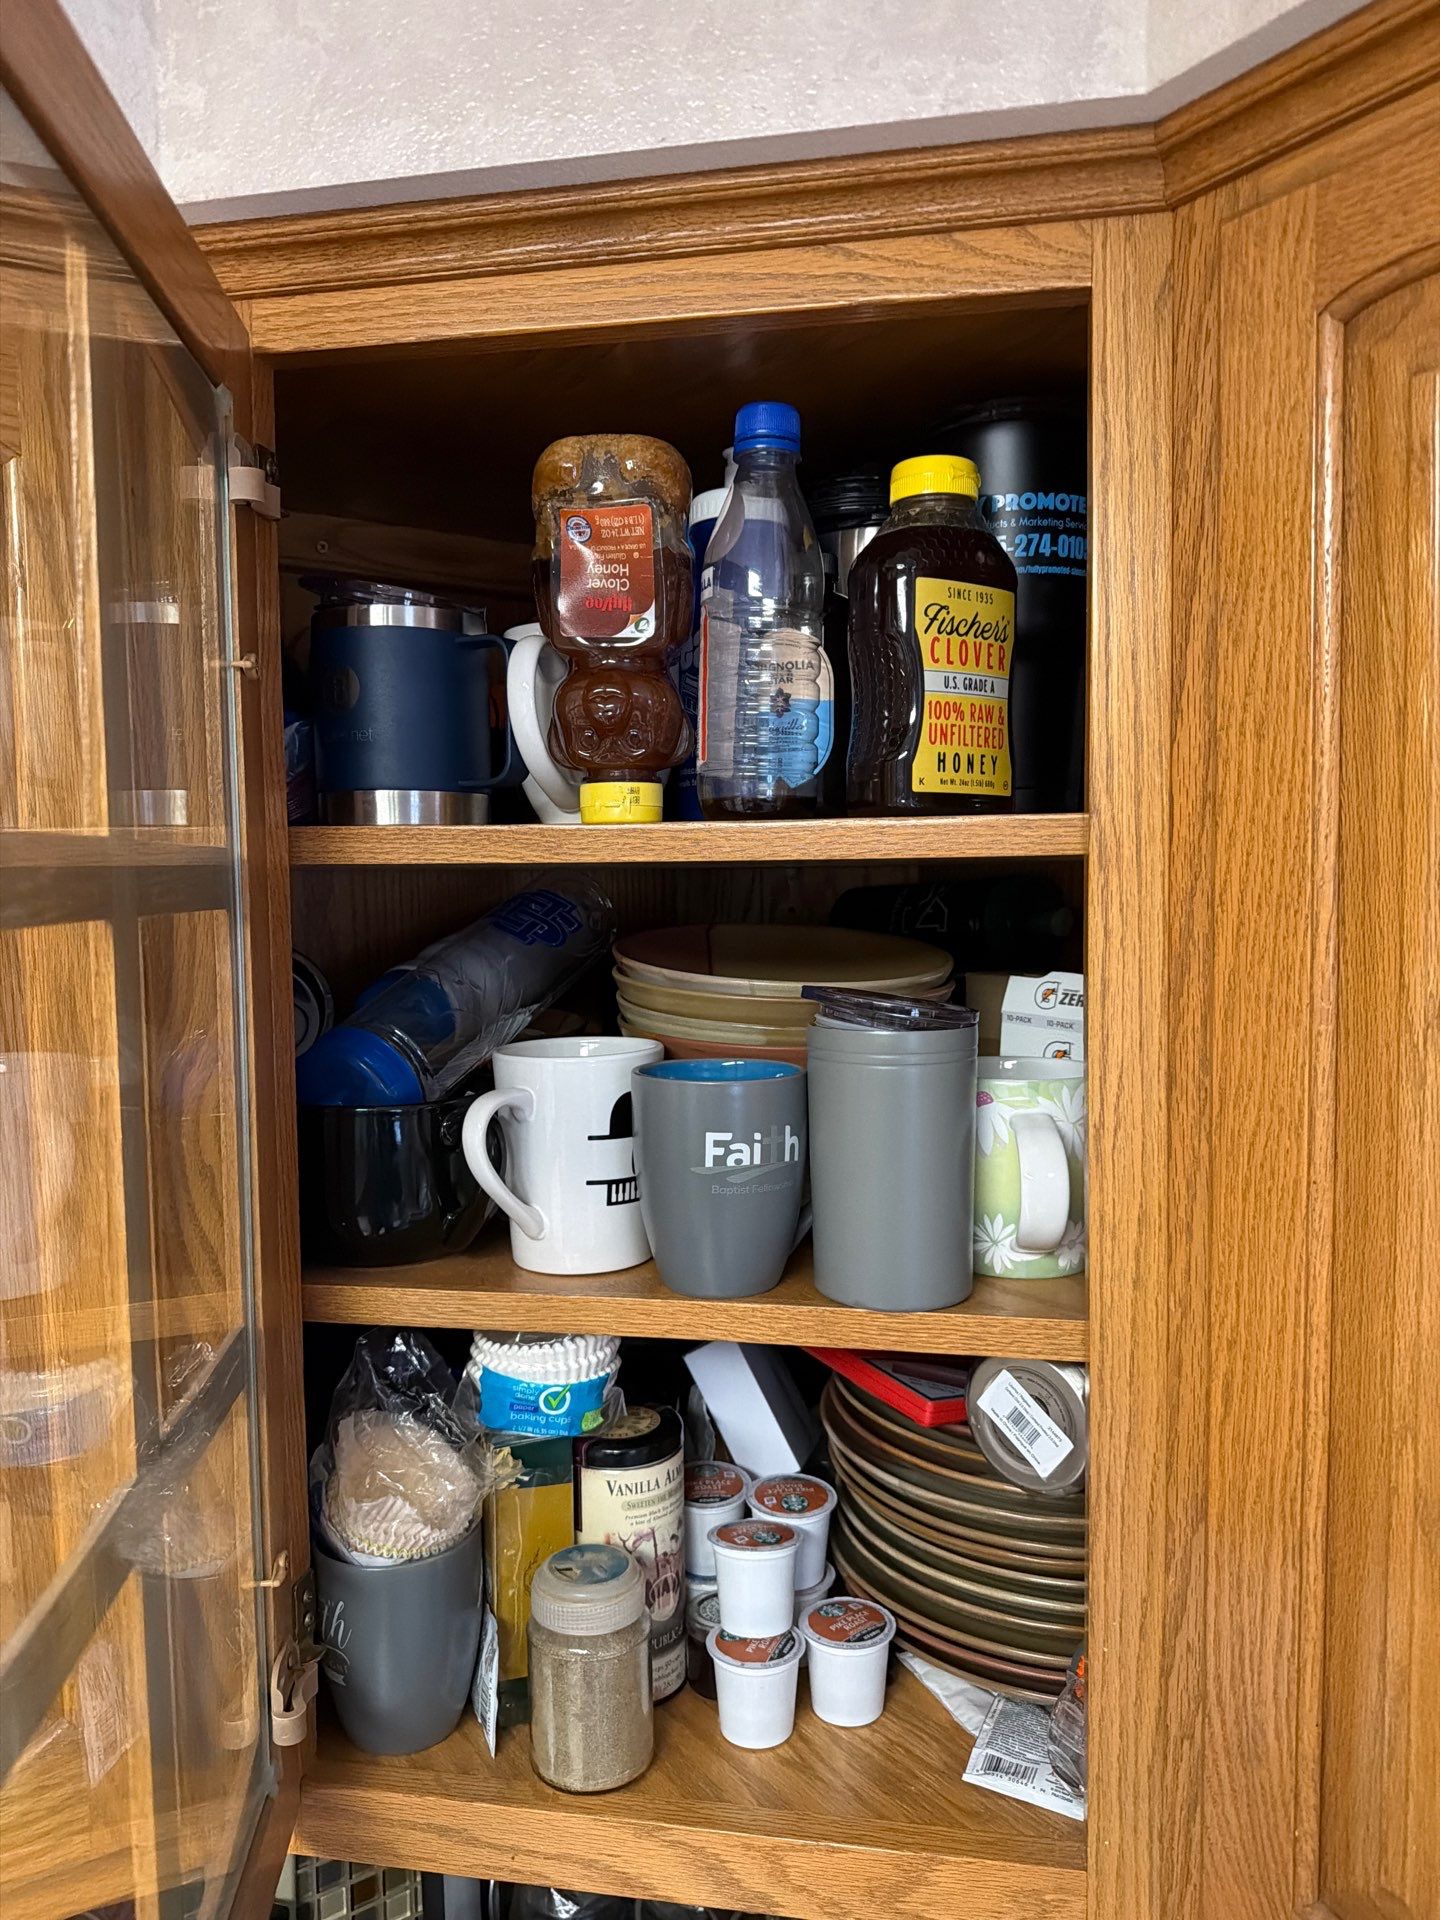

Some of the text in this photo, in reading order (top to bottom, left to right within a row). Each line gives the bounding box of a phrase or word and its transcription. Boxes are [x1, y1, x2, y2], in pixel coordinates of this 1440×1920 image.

[1019, 516, 1064, 530] Marketing
[630, 525, 645, 537] NET
[996, 533, 1087, 560] 5-274-010
[587, 562, 630, 577] Honey
[586, 578, 630, 592] Clover
[947, 586, 994, 605] SINCE 1935
[924, 602, 1010, 644] Fischer's
[930, 635, 1006, 672] CLOVER
[943, 675, 996, 694] U.S. GRADE A
[928, 699, 1005, 726] 100% RAW &
[928, 722, 1004, 750] UNFILTERED
[937, 751, 998, 776] HONEY
[919, 777, 925, 786] K
[1006, 1014, 1033, 1024] 10-PACK
[1046, 1019, 1074, 1030] 10-PACK
[704, 1124, 800, 1168] Faith
[711, 1184, 750, 1196] Baptist
[512, 1384, 540, 1396] simply
[514, 1392, 536, 1401] done
[513, 1404, 535, 1412] paper
[510, 1411, 547, 1424] baking
[548, 1416, 572, 1425] cups
[605, 1477, 661, 1498] VANILLA
